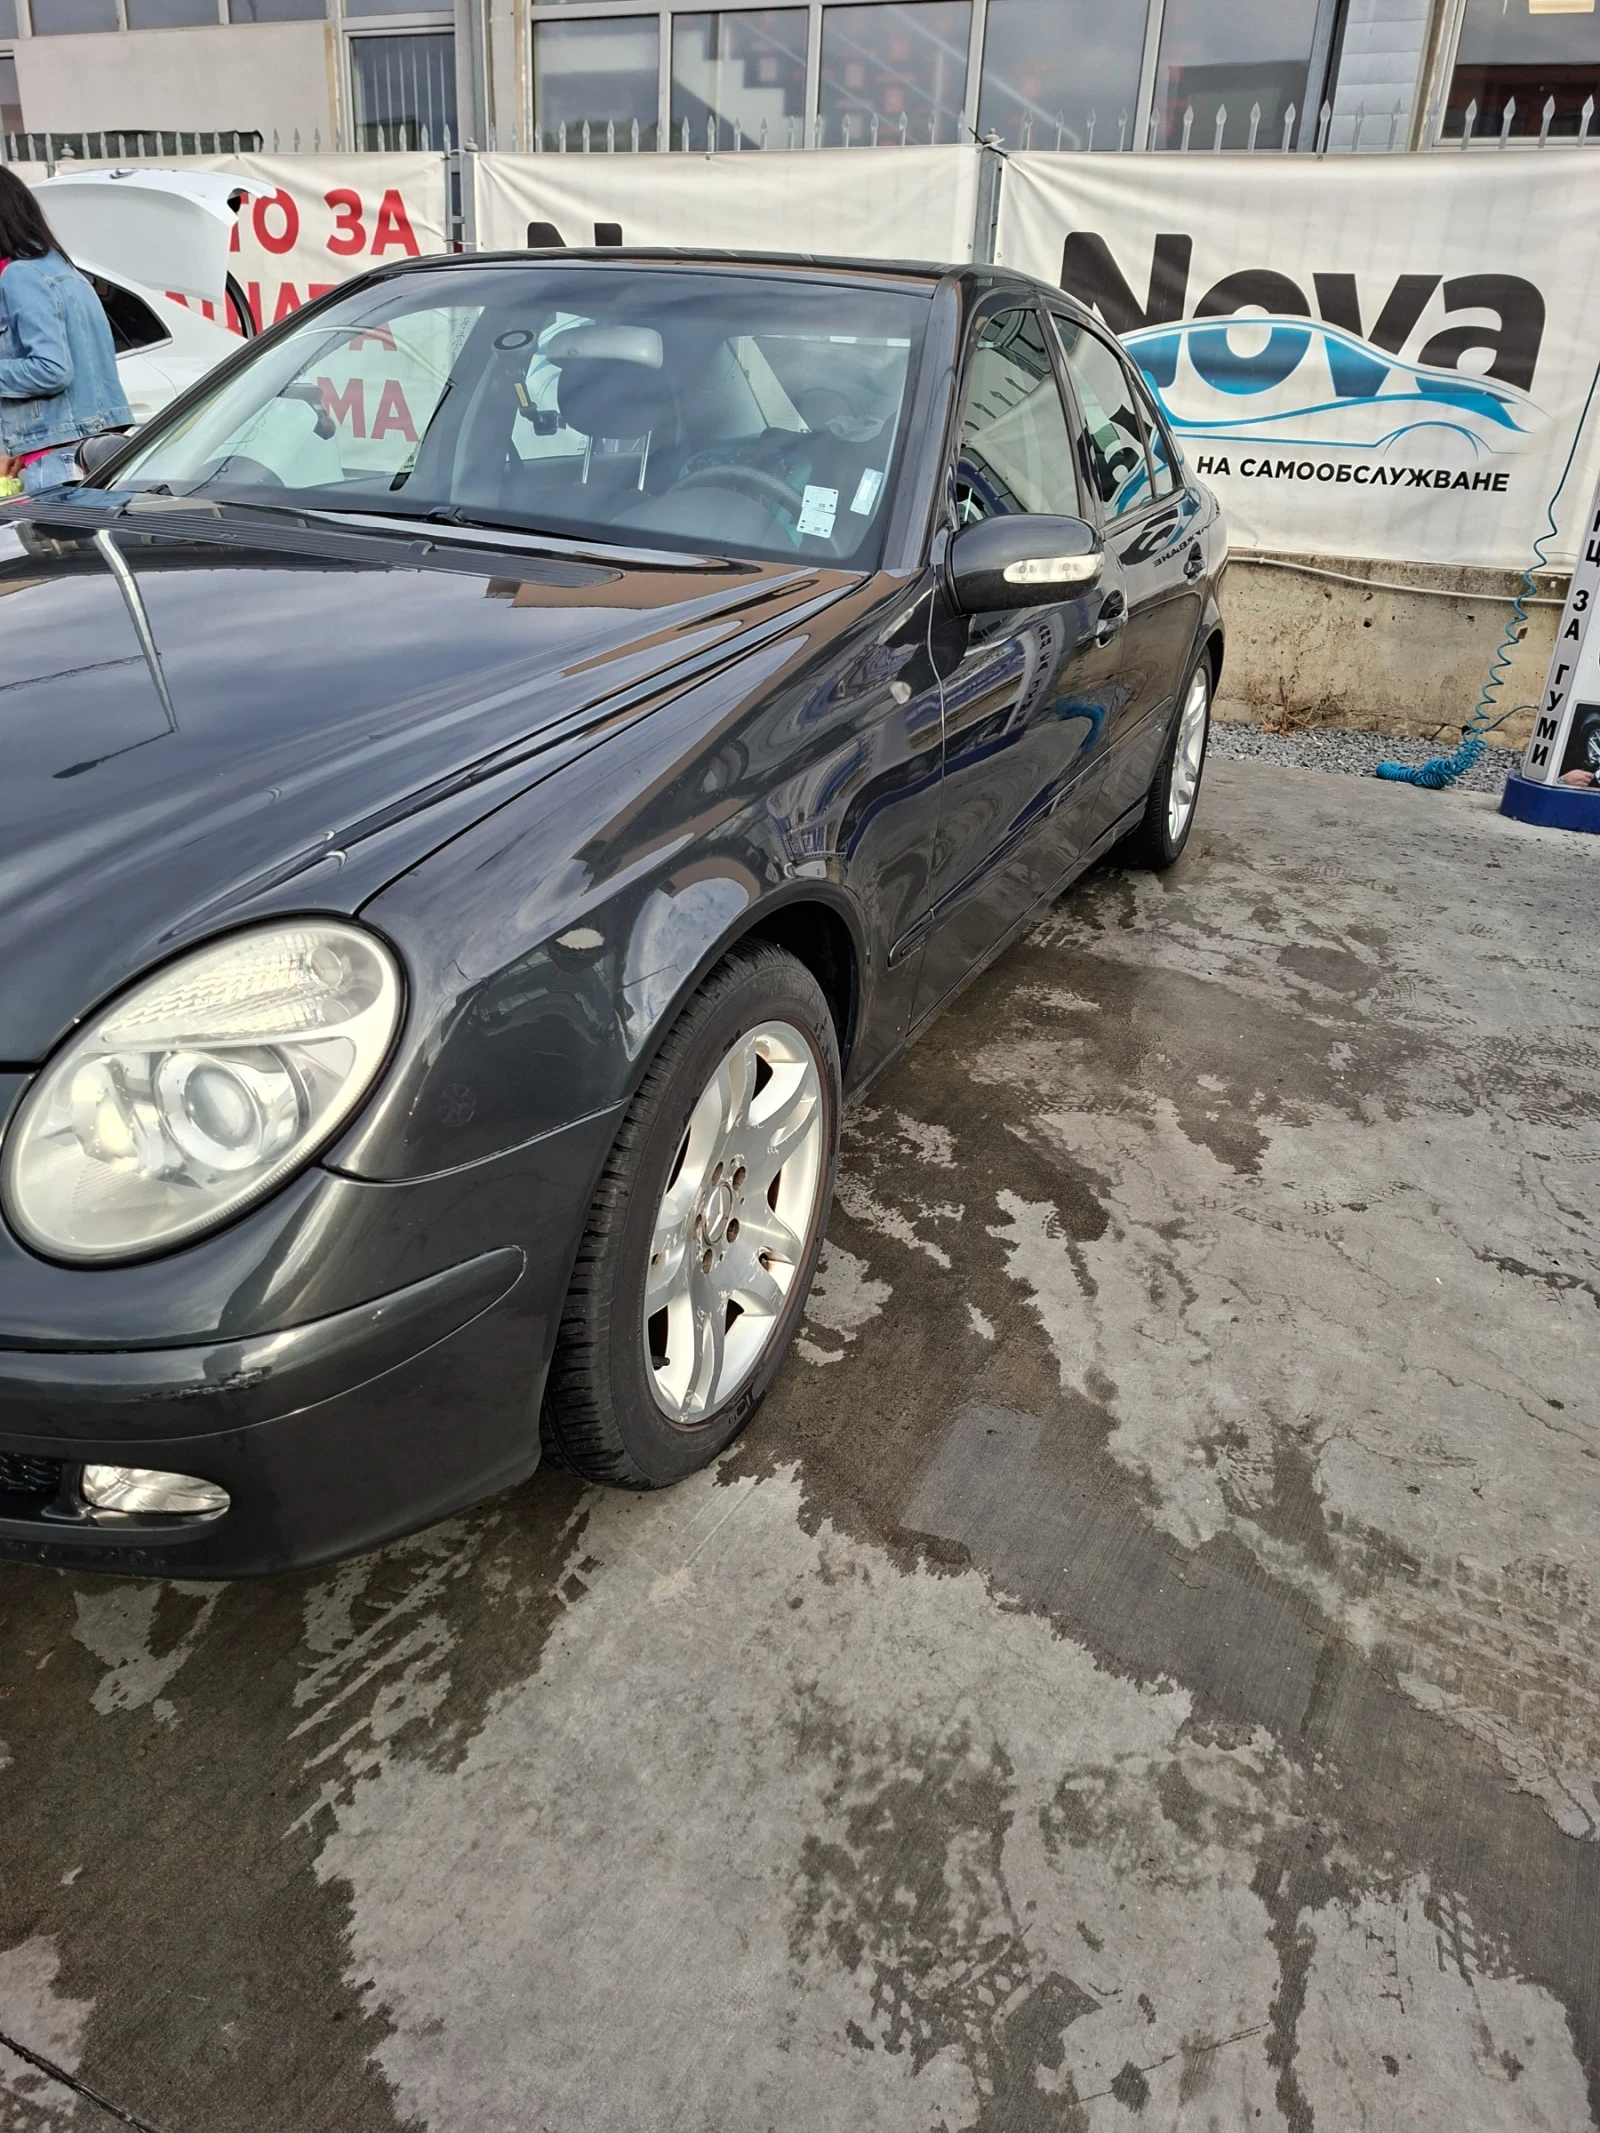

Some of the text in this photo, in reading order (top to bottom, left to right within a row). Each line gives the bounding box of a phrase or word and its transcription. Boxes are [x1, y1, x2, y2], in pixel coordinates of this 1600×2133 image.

[324, 189, 421, 256] ЗА
[1060, 231, 1546, 405] Nova
[1197, 456, 1510, 492] НА САМООБСЛУЖВАНЕ
[1564, 590, 1589, 641] ЗА
[1531, 664, 1570, 767] ГУМИ
